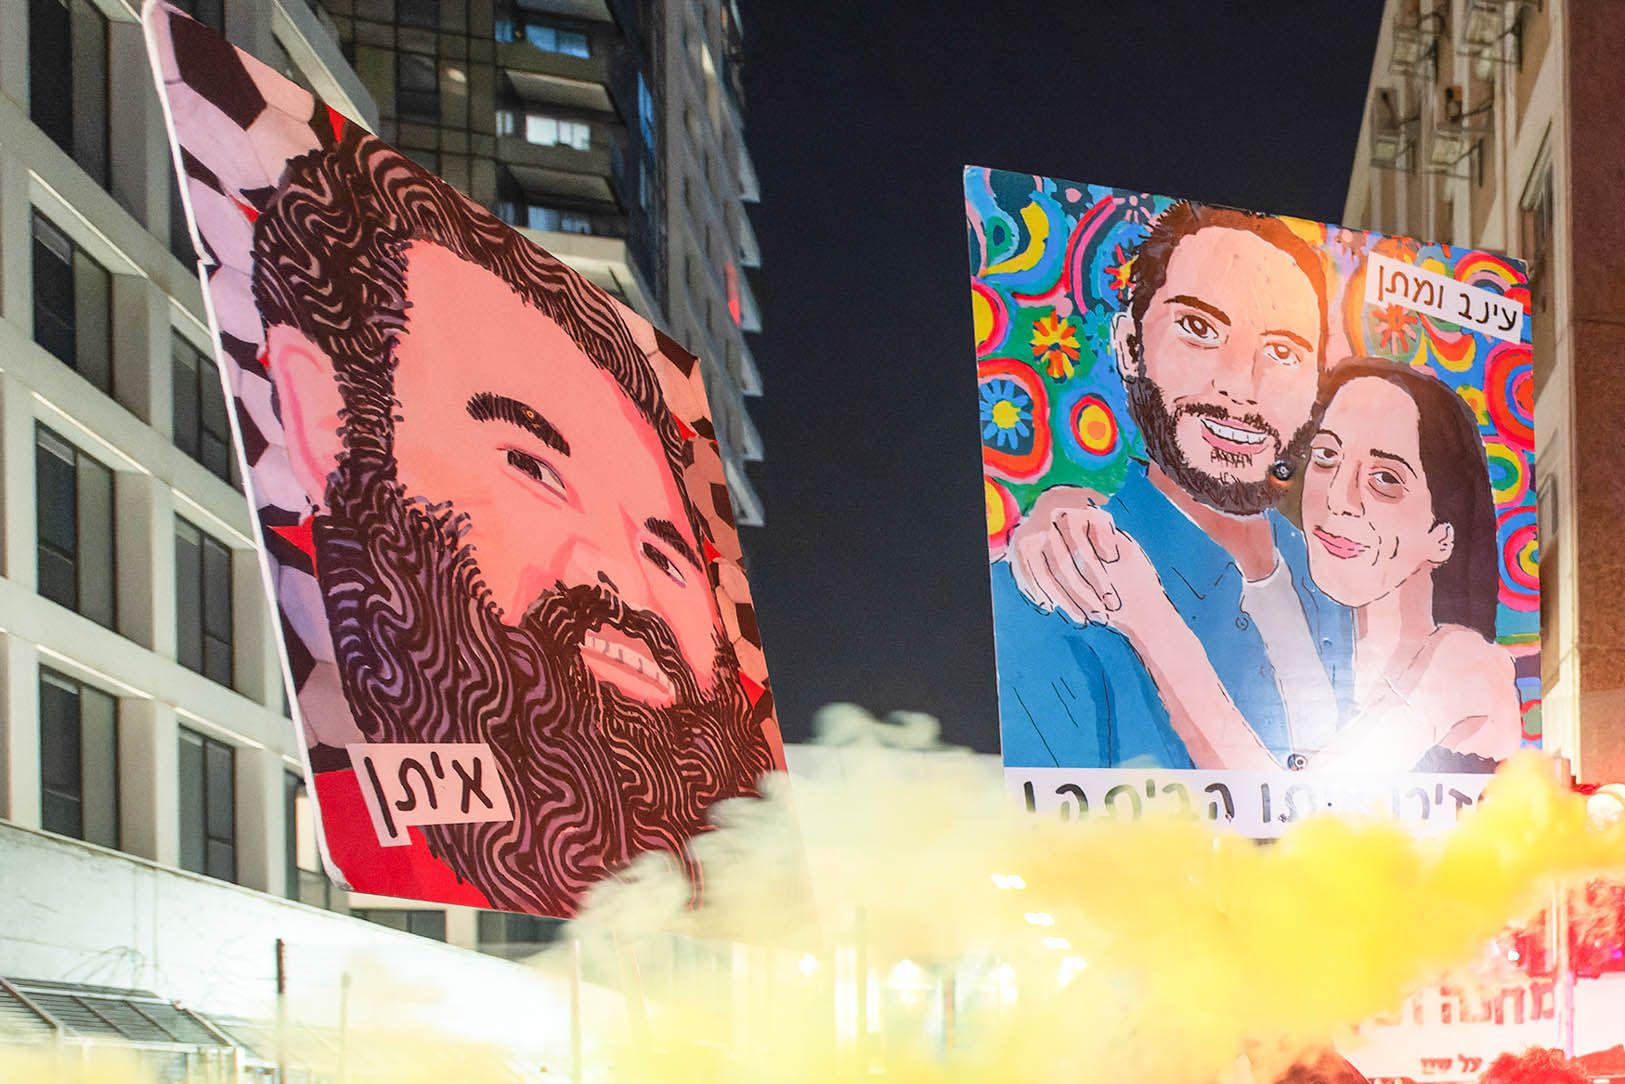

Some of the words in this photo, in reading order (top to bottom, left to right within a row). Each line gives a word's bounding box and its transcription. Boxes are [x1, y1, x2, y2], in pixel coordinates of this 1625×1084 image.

[1378, 265, 1444, 309] ומתן
[1458, 293, 1517, 331] עינב
[363, 751, 494, 839] איתן
